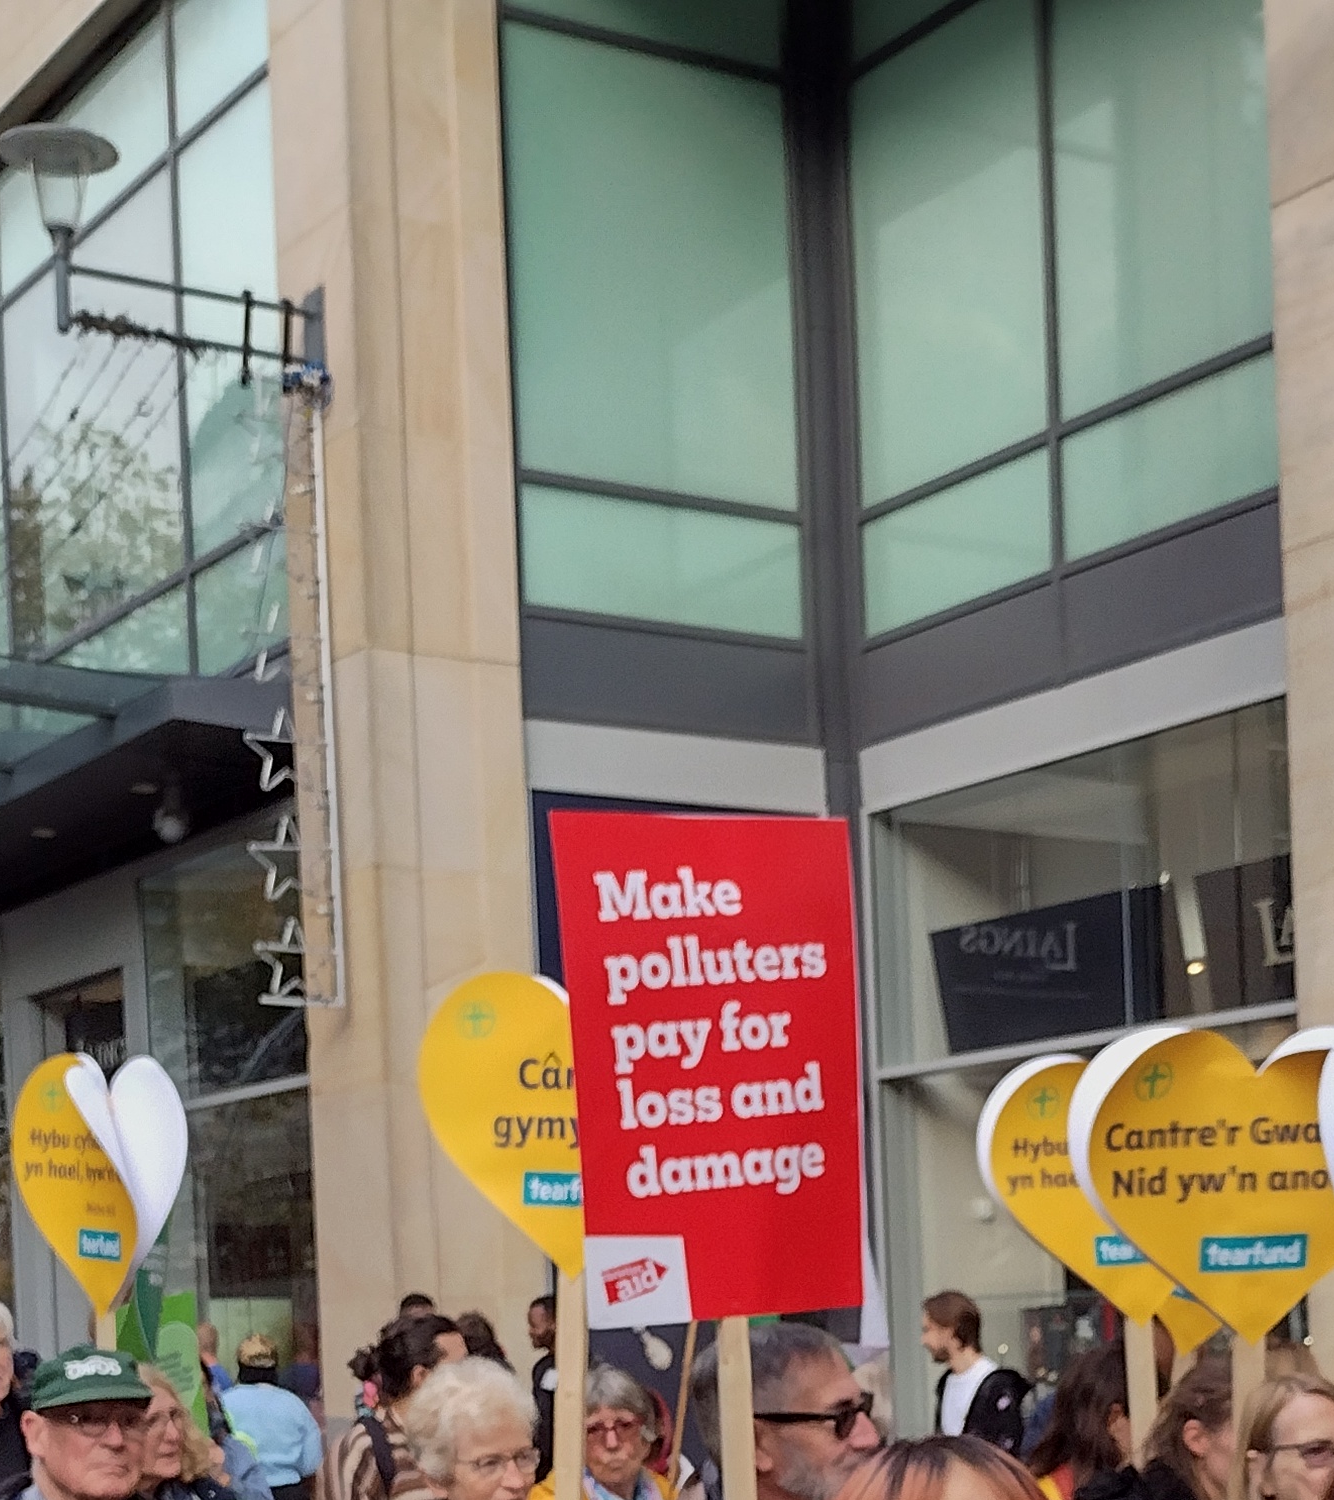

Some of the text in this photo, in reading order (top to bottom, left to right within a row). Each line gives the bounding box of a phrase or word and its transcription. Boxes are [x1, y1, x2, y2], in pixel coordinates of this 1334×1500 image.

[592, 865, 743, 922] Make
[603, 934, 827, 1005] polluters
[611, 1000, 791, 1075] pay for
[616, 1060, 825, 1130] loss and
[30, 1127, 70, 1152] Hybu
[1104, 1118, 1241, 1153] Cantre'r
[626, 1144, 825, 1199] damage
[1111, 1165, 1168, 1199] Nid
[1176, 1165, 1258, 1204] yw'n
